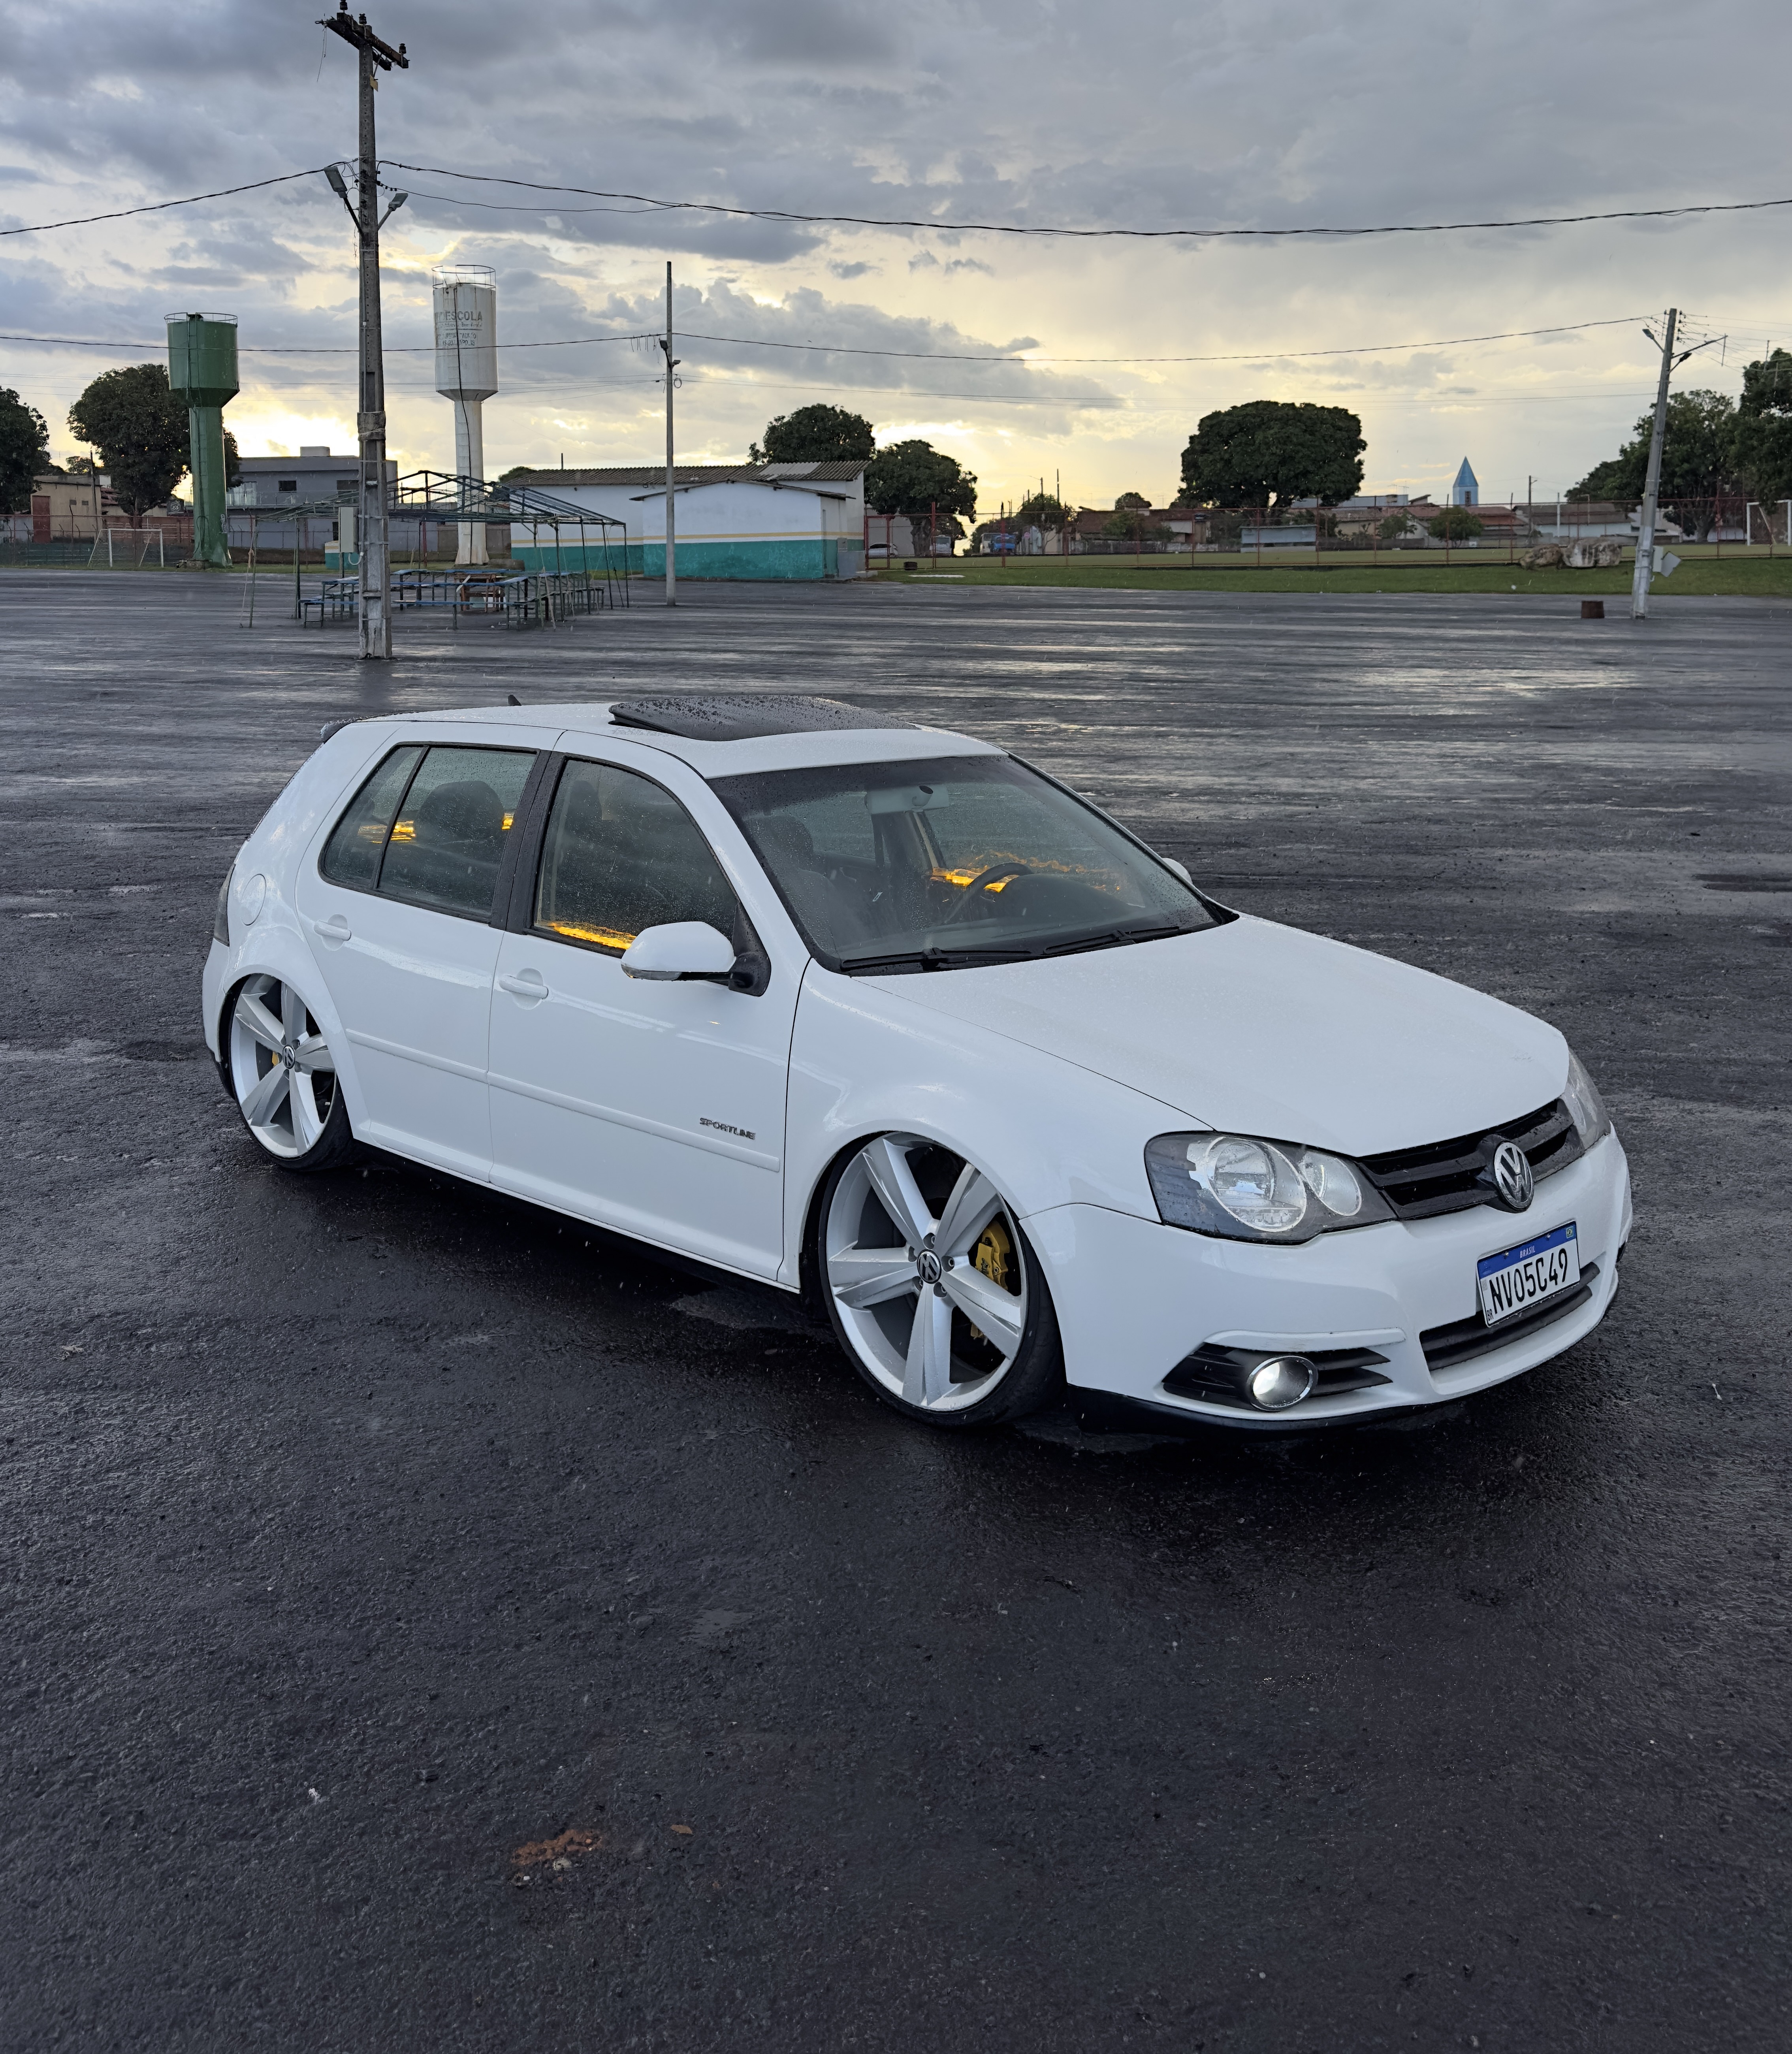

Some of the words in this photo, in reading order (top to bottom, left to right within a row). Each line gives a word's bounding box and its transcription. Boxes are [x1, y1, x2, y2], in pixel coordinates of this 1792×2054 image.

[699, 1117, 756, 1140] SPORTLINE
[1520, 1245, 1536, 1258] BRASIL
[1487, 1309, 1494, 1321] BR
